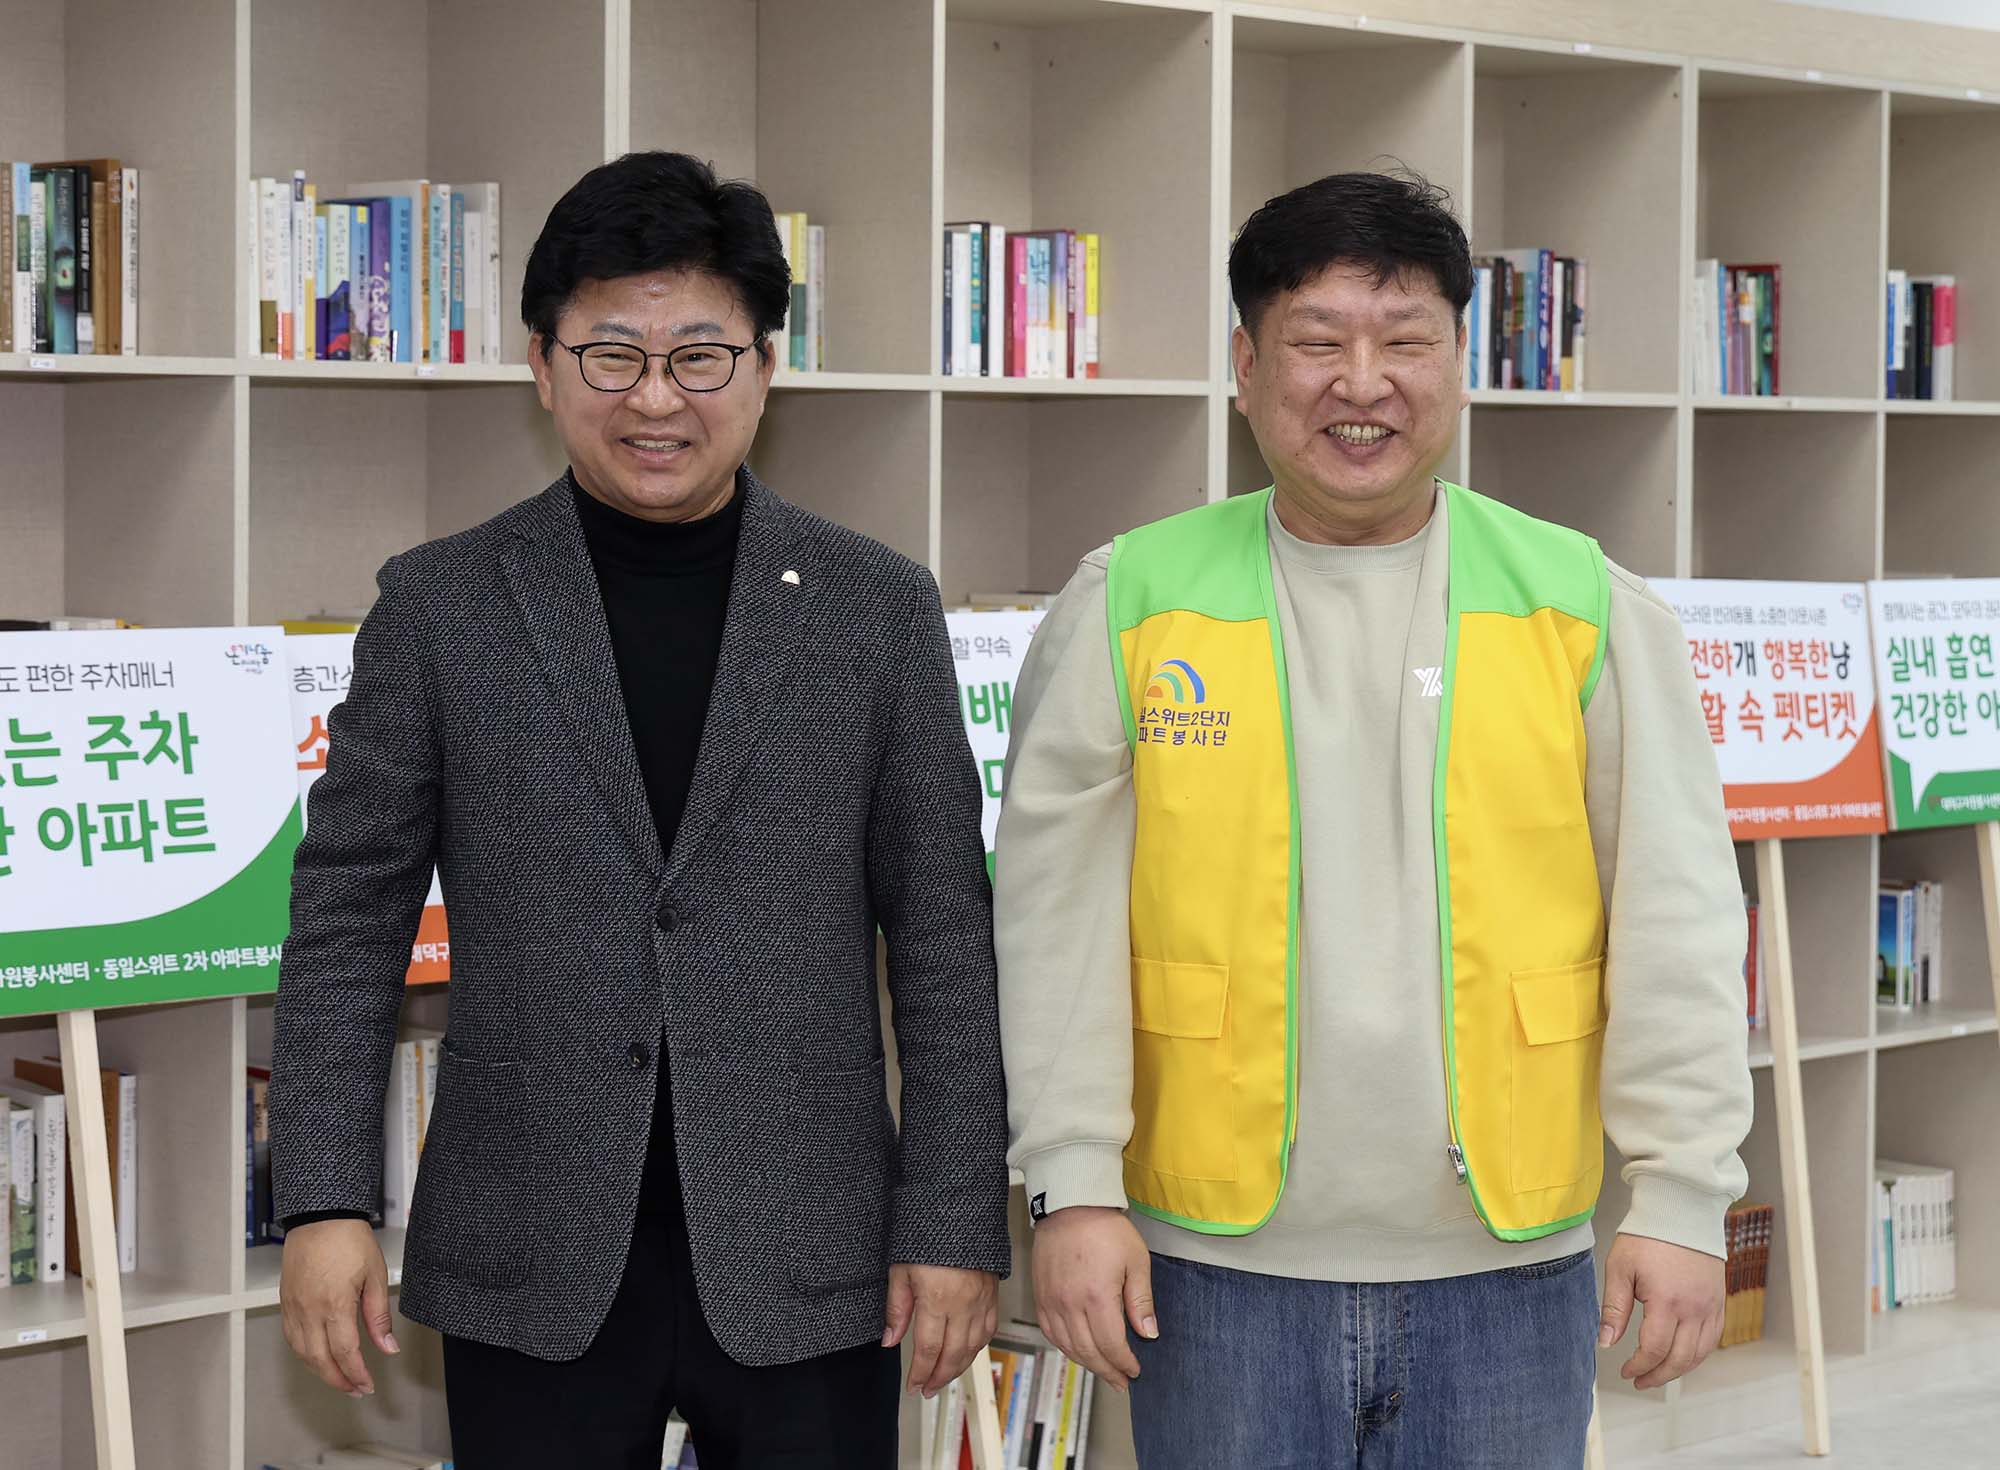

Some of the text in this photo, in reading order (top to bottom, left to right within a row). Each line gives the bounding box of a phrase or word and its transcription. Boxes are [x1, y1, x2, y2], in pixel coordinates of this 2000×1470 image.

[974, 635, 1012, 659] 약속
[1688, 638, 1850, 680] 전하개 행복한냥
[1887, 631, 1995, 682] 실내 흡연
[26, 663, 75, 692] 편한
[81, 661, 174, 691] 주차매너
[958, 680, 1013, 733] 배
[1738, 689, 1764, 743] 속
[1773, 690, 1857, 742] 펫티켓
[1891, 690, 1967, 739] 건강한
[0, 710, 199, 788] 는 주차
[37, 798, 216, 867] 아파트
[103, 953, 180, 981] 동일스위트
[183, 949, 208, 973] 2차
